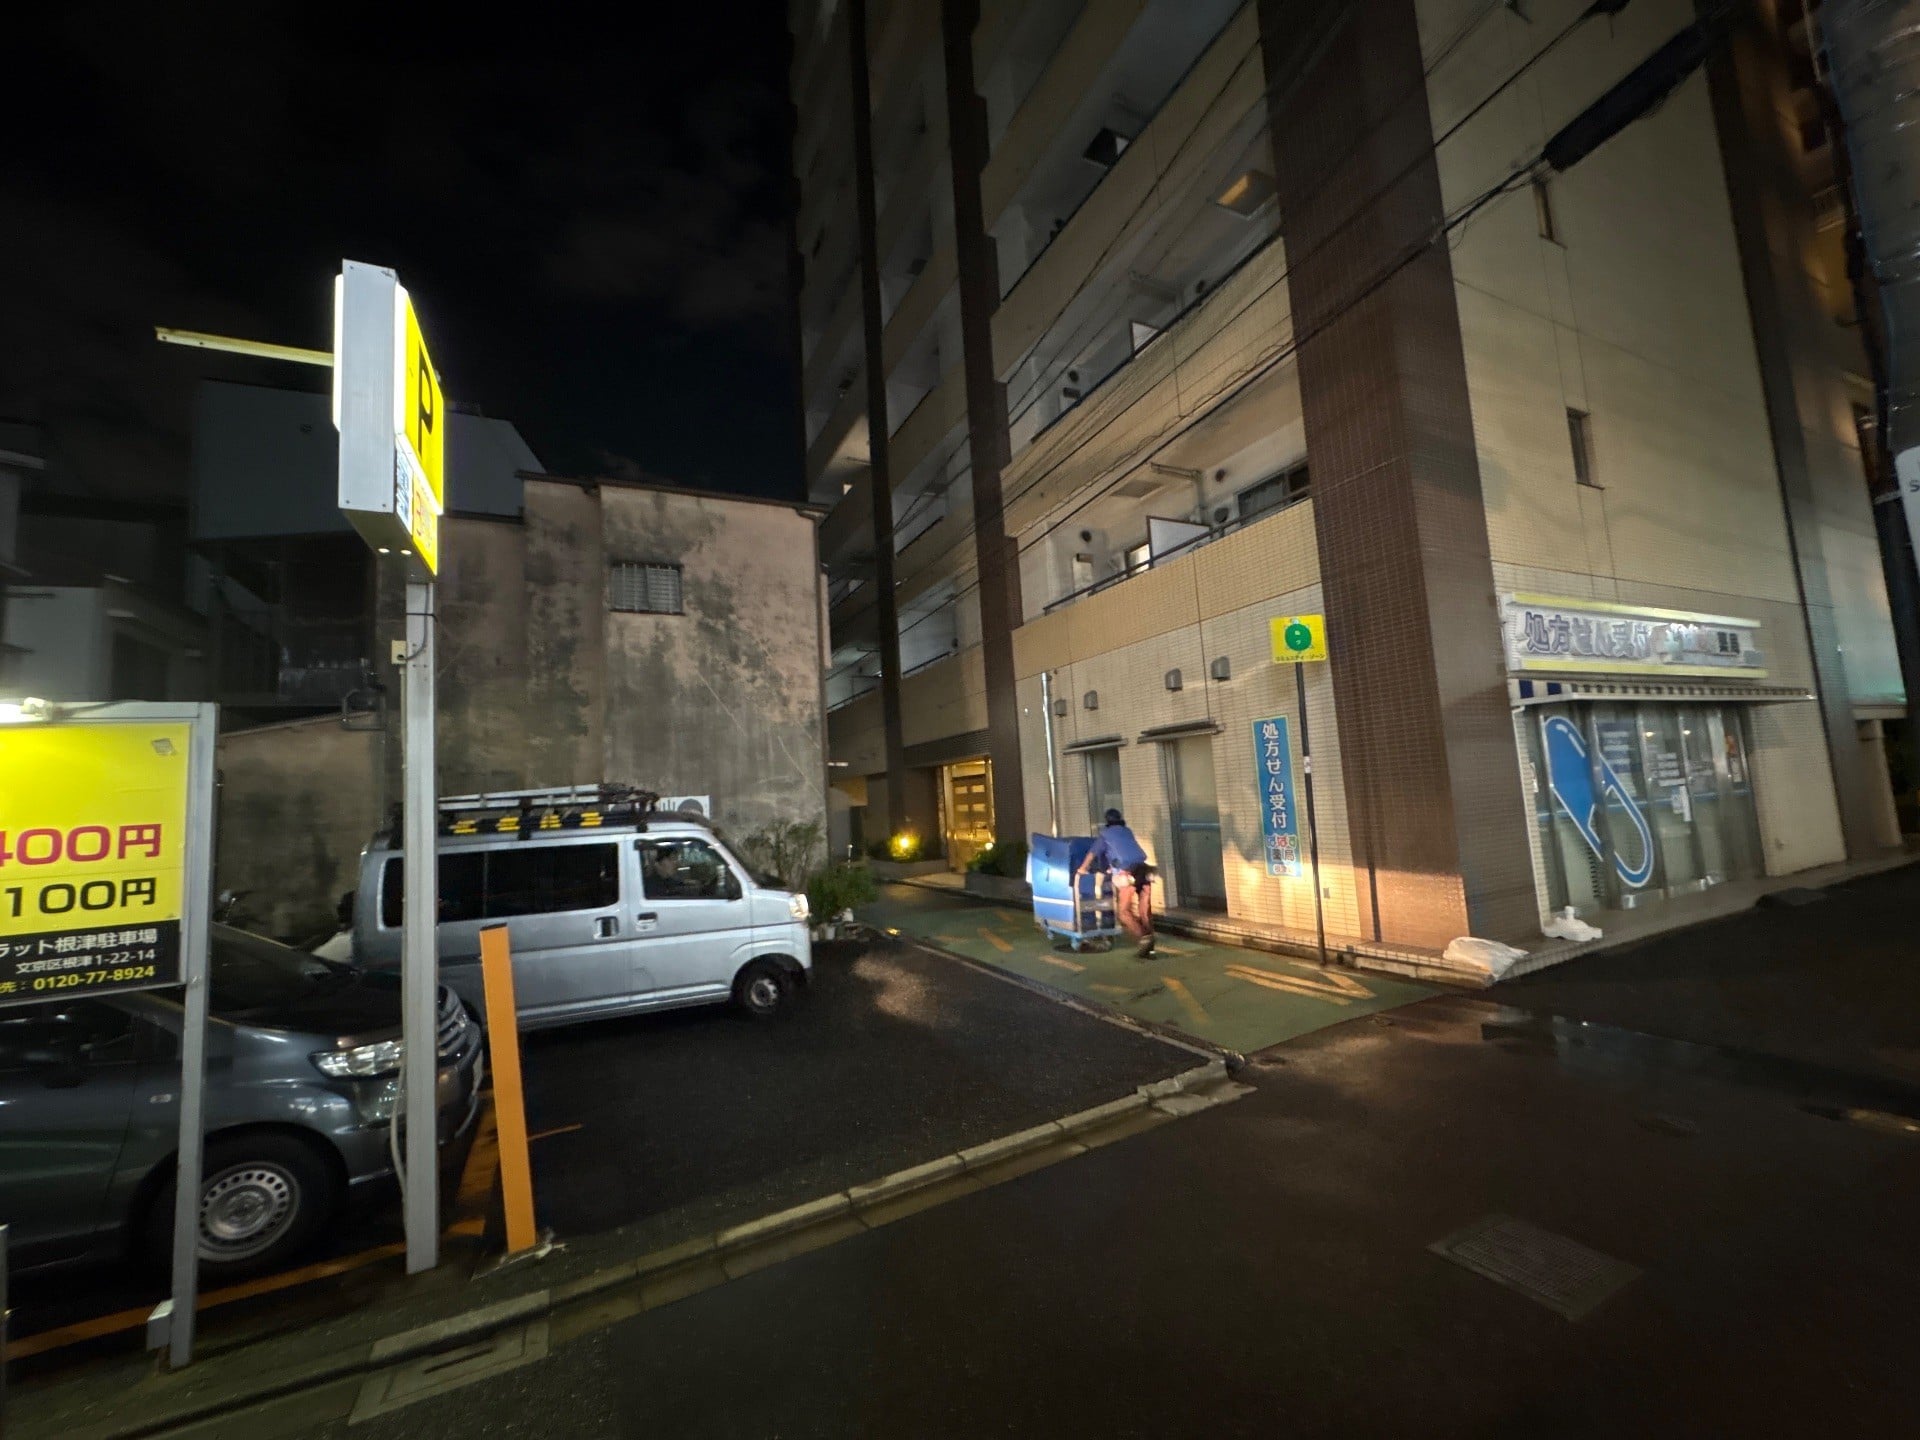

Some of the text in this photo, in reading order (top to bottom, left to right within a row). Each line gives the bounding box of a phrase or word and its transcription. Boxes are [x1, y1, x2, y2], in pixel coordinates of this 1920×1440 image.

[418, 340, 433, 460] P
[1262, 722, 1287, 829] 処方せん受付
[0, 823, 161, 867] 00円
[5, 877, 156, 917] 100円
[33, 965, 155, 990] 0120-77-8924
